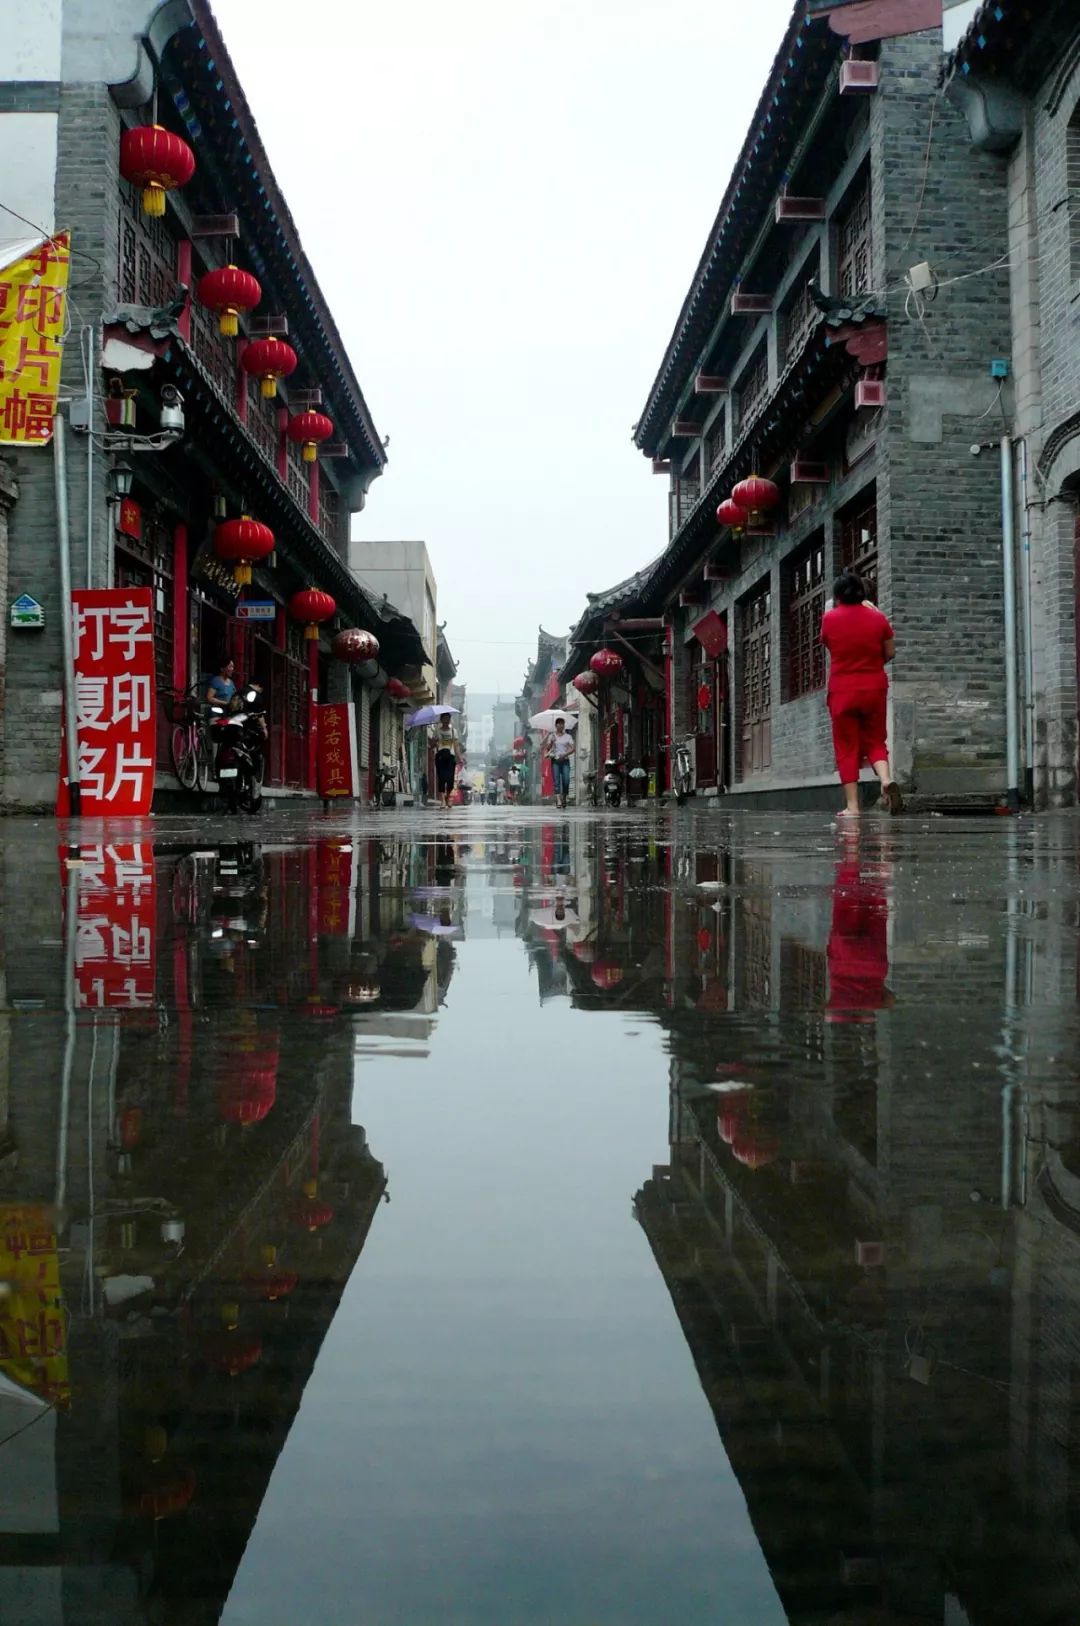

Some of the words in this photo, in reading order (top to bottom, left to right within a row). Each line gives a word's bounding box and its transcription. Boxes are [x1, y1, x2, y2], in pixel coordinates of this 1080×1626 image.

[72, 600, 152, 661] 打字
[75, 672, 152, 733] 复印
[63, 741, 152, 802] 名片
